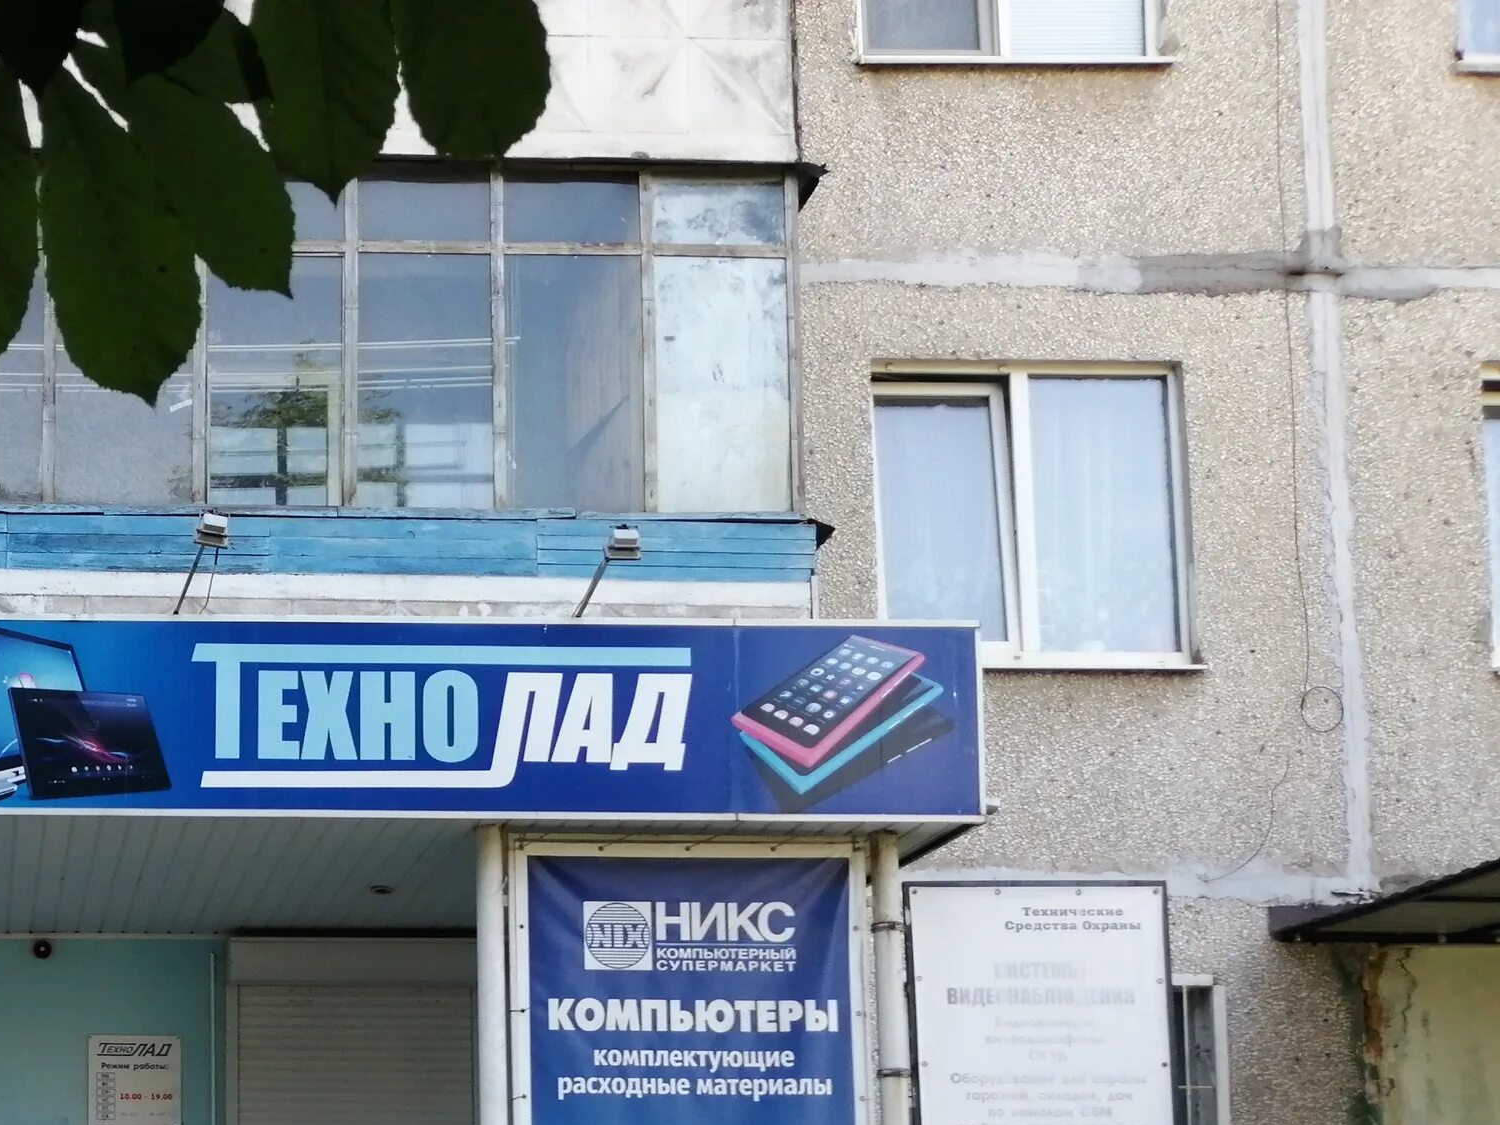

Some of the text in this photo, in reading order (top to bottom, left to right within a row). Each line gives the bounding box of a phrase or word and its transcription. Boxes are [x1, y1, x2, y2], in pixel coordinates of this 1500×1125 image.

[656, 901, 795, 942] НИКС
[1021, 907, 1125, 917] Технические
[1004, 920, 1142, 933] Средства Охраны
[656, 946, 797, 961] КОМПЬЮТЕРНЫЙ
[656, 960, 797, 973] СУПЕРМАРКЕТ
[548, 997, 839, 1033] КОМПЬЮТЕРЫ
[594, 1048, 795, 1073] комплектующие
[557, 1076, 833, 1101] расходные материалы
